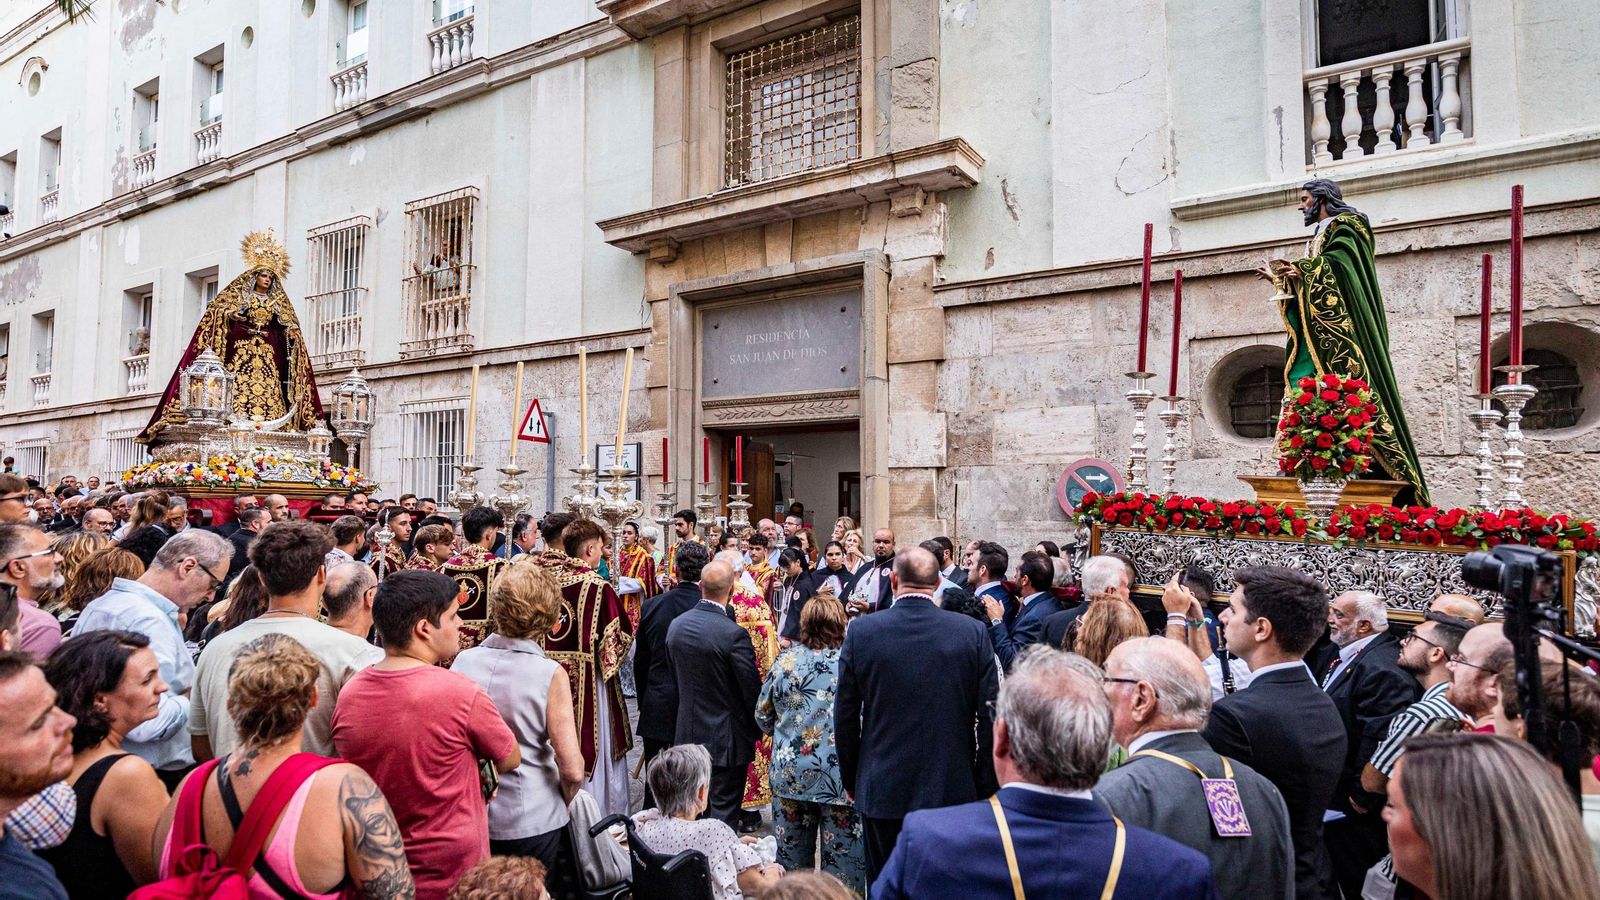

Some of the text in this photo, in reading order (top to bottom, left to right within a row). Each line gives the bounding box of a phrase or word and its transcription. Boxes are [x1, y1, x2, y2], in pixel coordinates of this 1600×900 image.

[745, 329, 810, 345] RESIDENCIA
[729, 346, 828, 365] SAN JUAN DE DIOS
